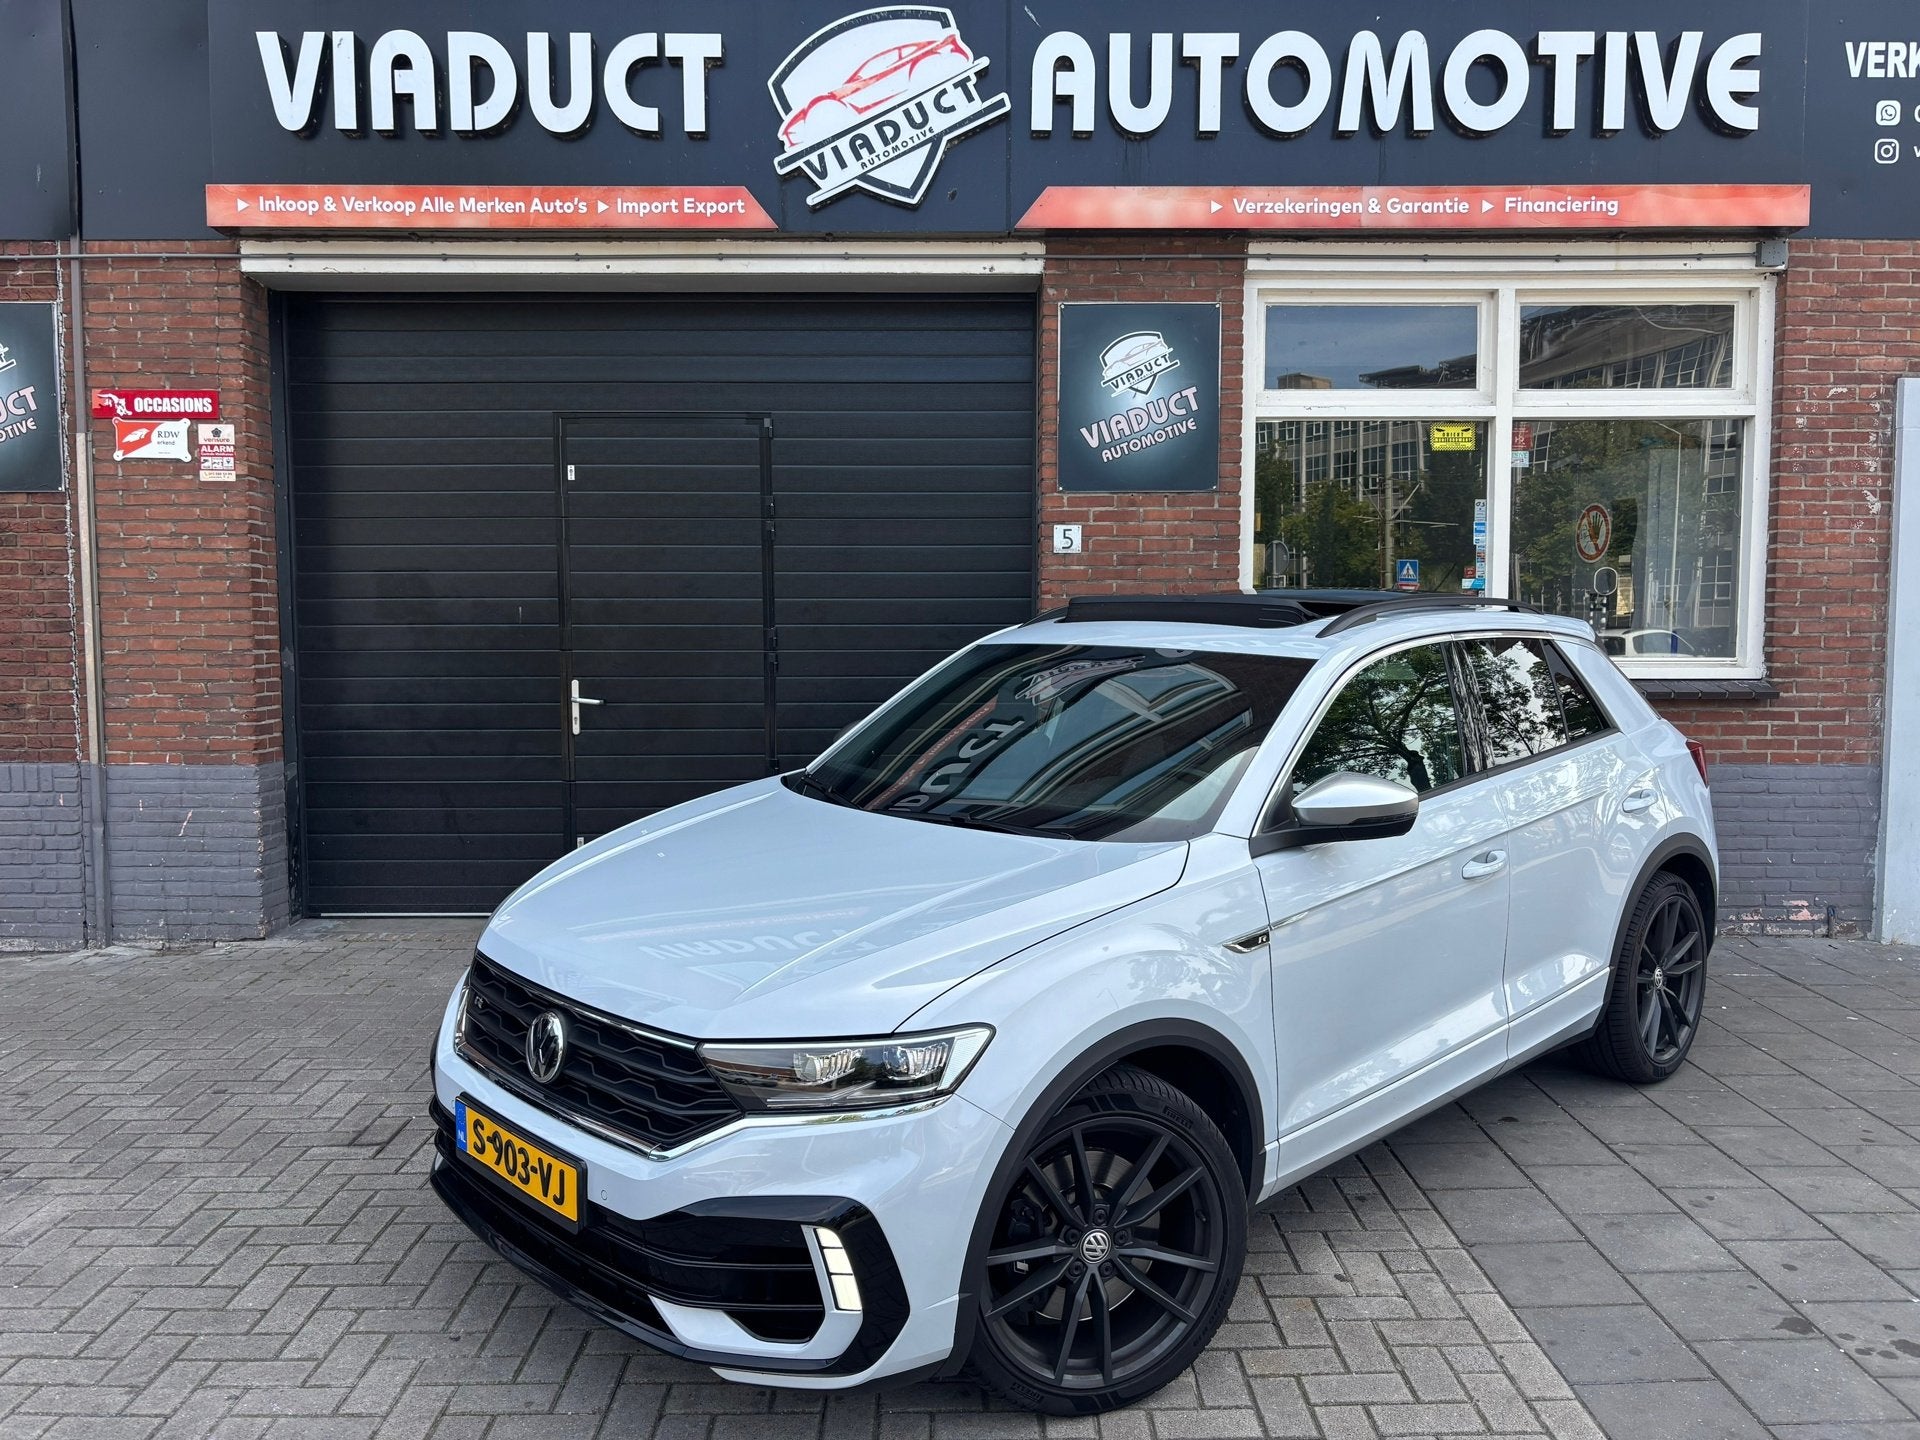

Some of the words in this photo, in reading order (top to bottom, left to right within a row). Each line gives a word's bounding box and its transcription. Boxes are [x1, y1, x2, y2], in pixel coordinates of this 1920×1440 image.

[256, 29, 722, 133] VIADUCT
[1031, 29, 1762, 133] AUTOMOTIVE
[803, 75, 978, 180] VIADUCT
[860, 126, 935, 170] AUTOMOTIVE
[259, 196, 319, 215] Inkoop
[324, 197, 337, 212] &
[342, 196, 416, 216] Verkoop
[421, 196, 454, 213] Alle
[459, 197, 525, 213] Merken
[530, 197, 587, 214] Auto's
[617, 198, 678, 217] Import
[684, 198, 745, 217] Export
[1233, 197, 1362, 216] Verzekeringen
[1368, 198, 1381, 214] &
[1387, 198, 1469, 214] Garantie
[1505, 196, 1618, 215] Financiering
[1111, 354, 1169, 389] VIADUCT
[134, 397, 213, 413] OCCASIONS
[1080, 386, 1199, 449] VIADUCT
[157, 430, 181, 439] RDW
[1101, 418, 1197, 463] AUTOMOTIVE
[200, 444, 234, 453] ALARM
[1061, 529, 1074, 550] 5
[457, 1130, 466, 1143] NL
[473, 1118, 565, 1206] S-903-VJ
